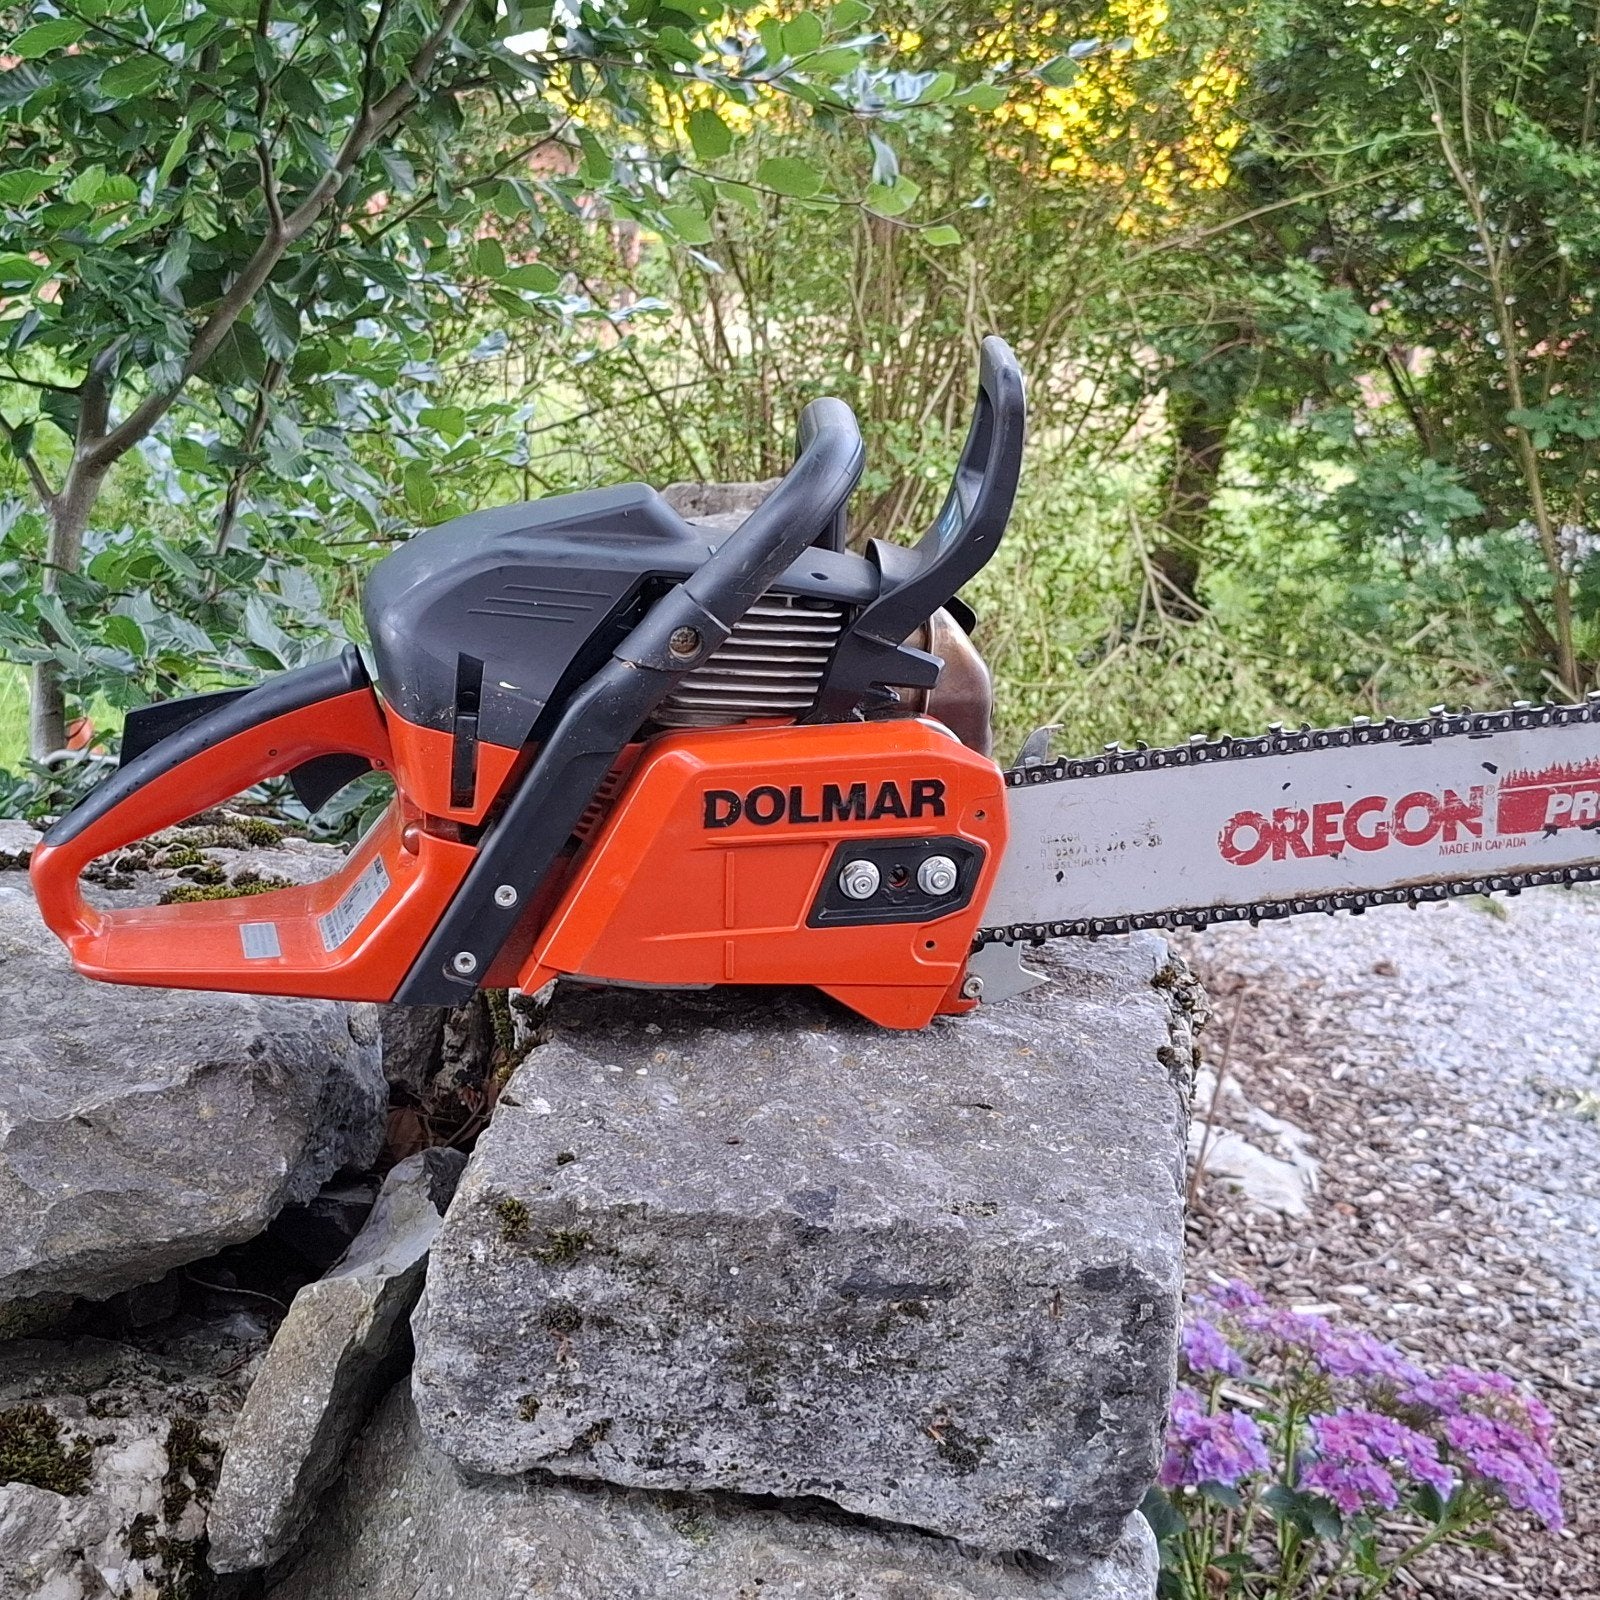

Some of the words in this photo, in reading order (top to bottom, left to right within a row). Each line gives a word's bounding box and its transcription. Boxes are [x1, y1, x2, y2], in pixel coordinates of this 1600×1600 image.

[703, 779, 946, 829] DOLMAR
[1218, 785, 1484, 866] OREGON
[1544, 790, 1600, 824] PR
[1439, 842, 1469, 856] MADE
[1471, 841, 1482, 853] IN
